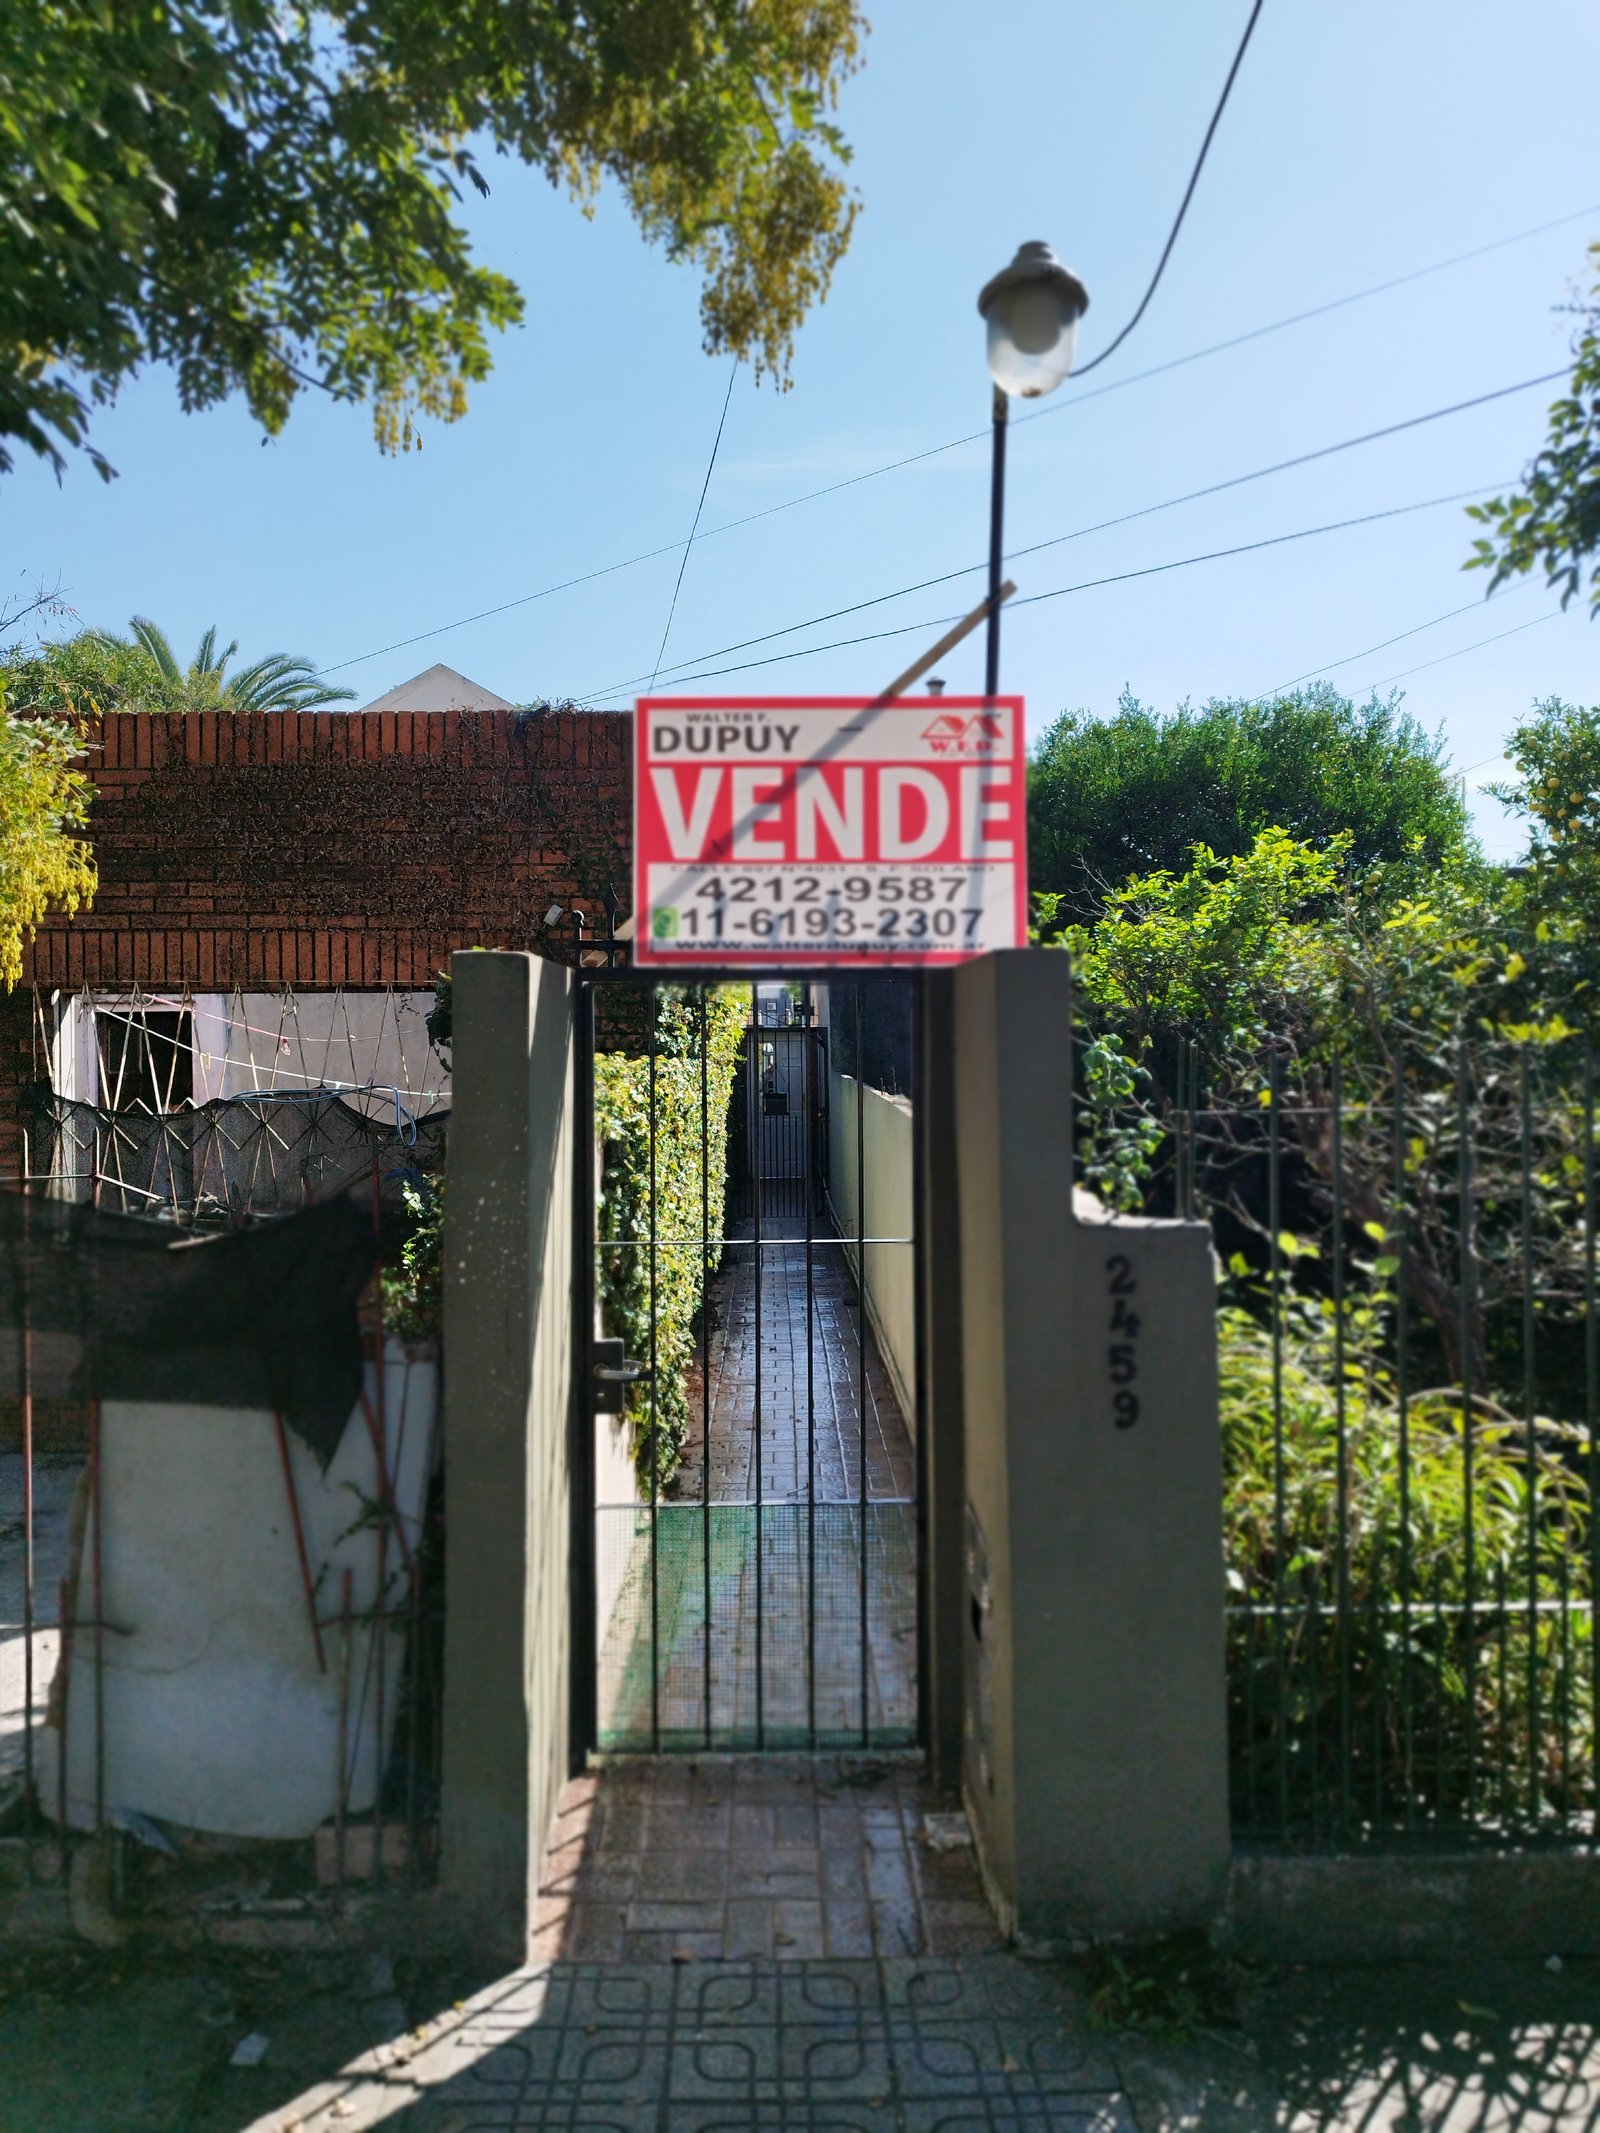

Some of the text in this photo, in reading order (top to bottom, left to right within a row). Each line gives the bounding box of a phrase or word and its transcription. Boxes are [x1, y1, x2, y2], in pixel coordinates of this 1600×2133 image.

[686, 712, 772, 723] WALTER F.
[653, 725, 800, 754] DUPUY
[649, 766, 1014, 860] VENDE
[696, 876, 968, 903] 4212-9587
[681, 907, 985, 938] 11-6193-2307
[675, 940, 986, 952] www.walterdupuy.com.ar
[1106, 1254, 1141, 1430] 2459
